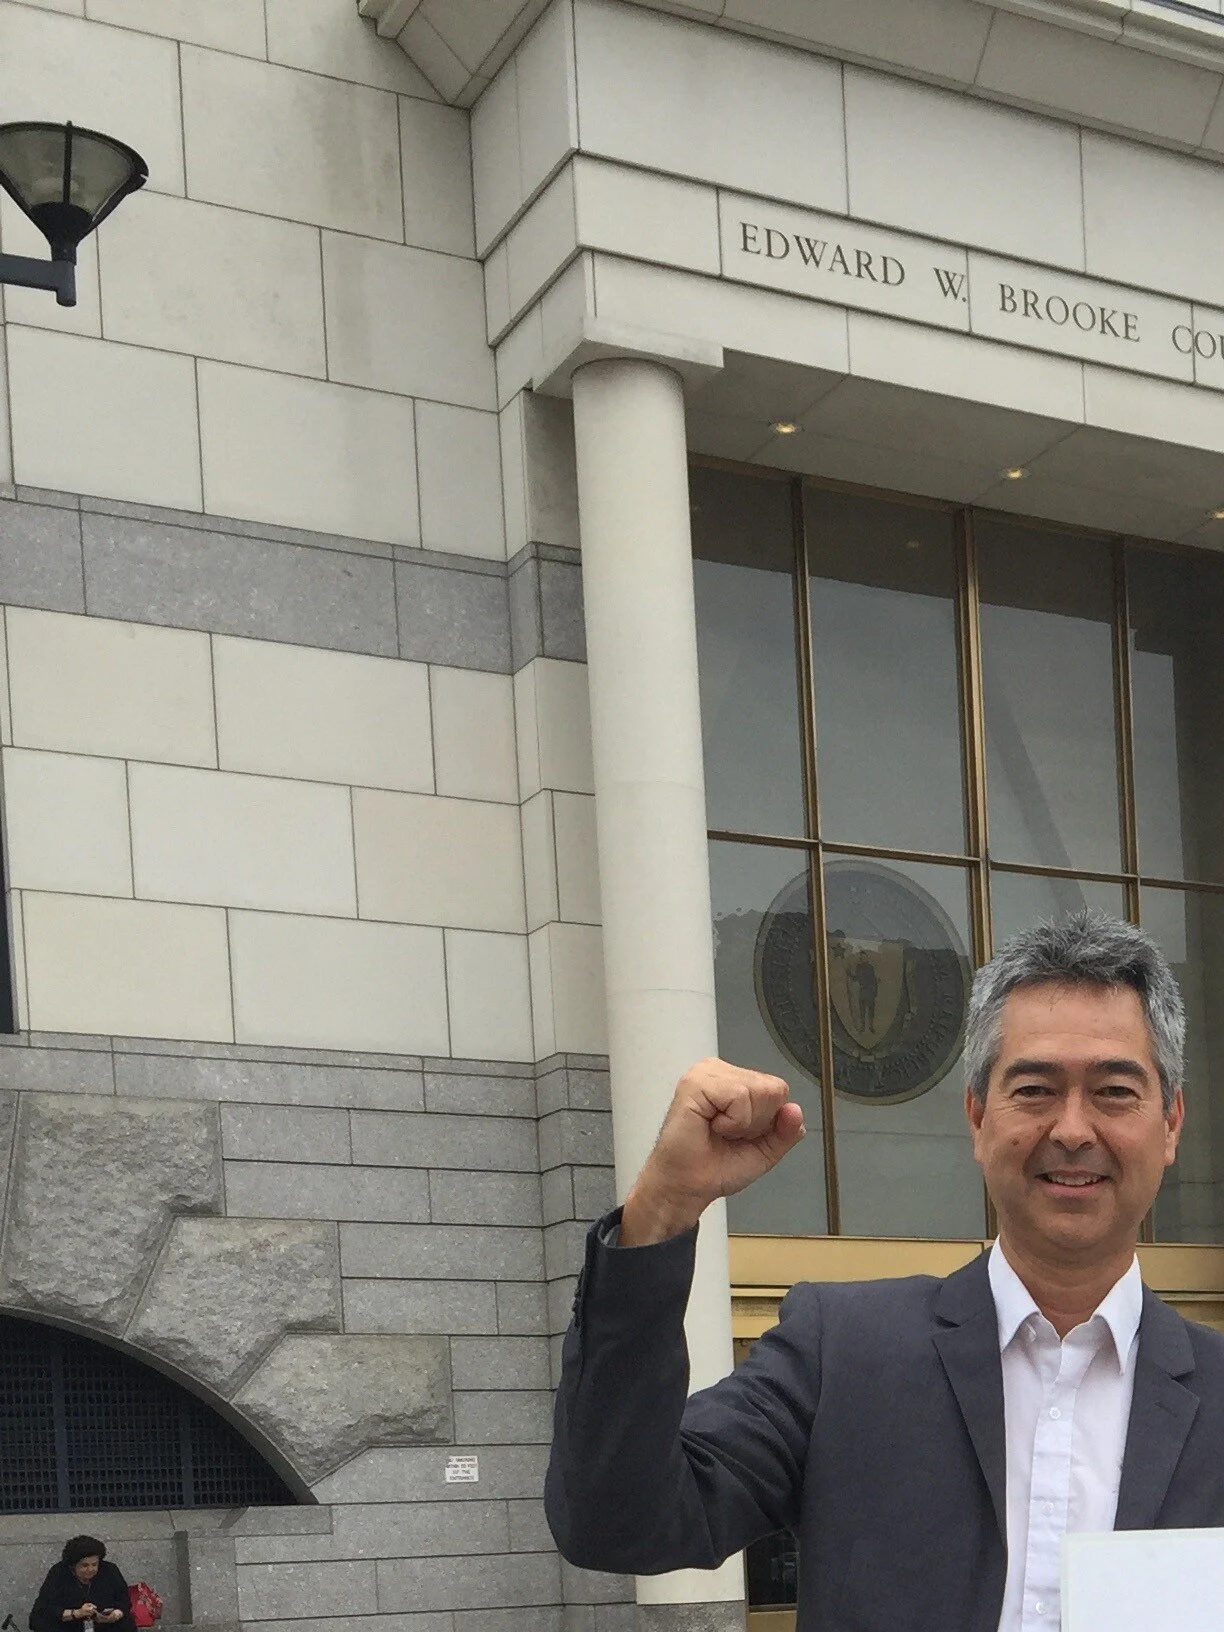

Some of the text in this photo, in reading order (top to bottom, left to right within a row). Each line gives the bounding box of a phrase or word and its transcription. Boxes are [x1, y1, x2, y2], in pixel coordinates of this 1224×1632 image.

[740, 221, 906, 287] EDWARD
[933, 267, 967, 303] W.
[999, 283, 1141, 344] BROOKE
